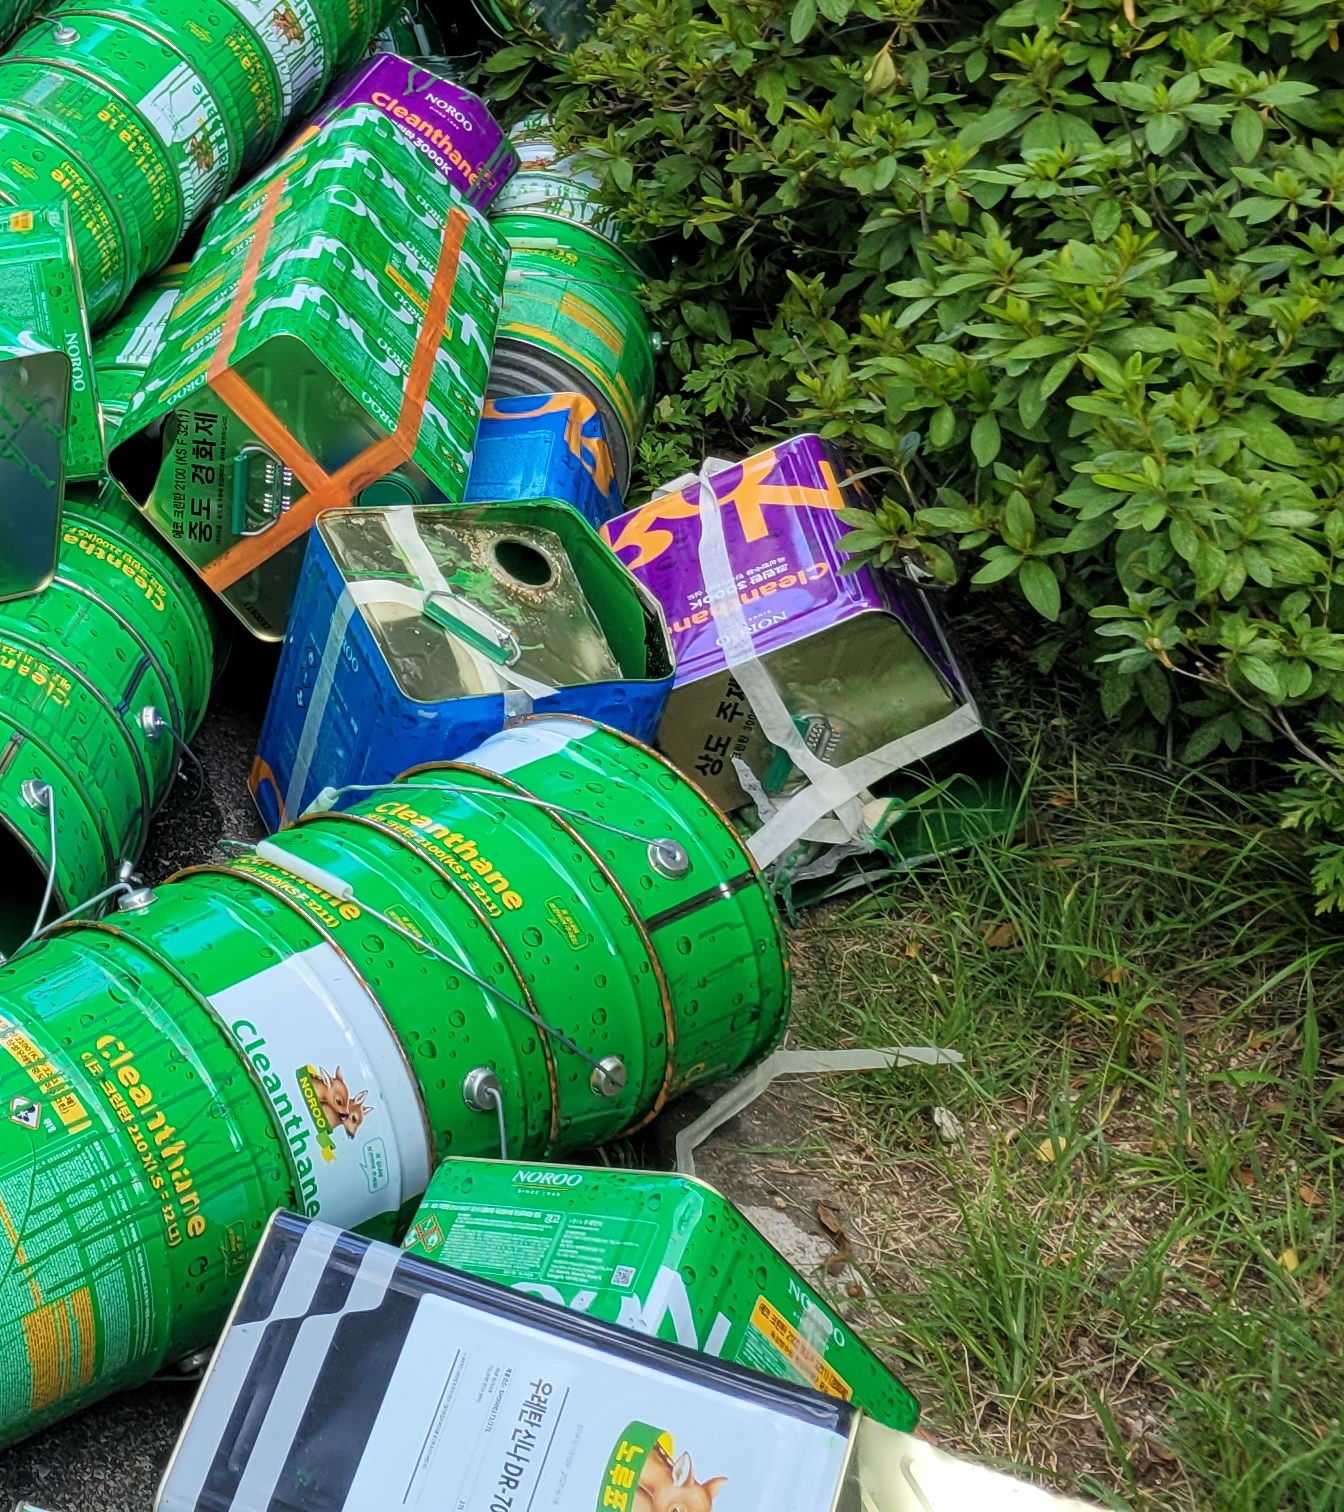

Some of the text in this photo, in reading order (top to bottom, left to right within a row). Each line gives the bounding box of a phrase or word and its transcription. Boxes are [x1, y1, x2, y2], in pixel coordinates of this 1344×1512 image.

[424, 92, 473, 132] NOROO
[373, 92, 482, 186] Cleanthane
[412, 133, 453, 176] 3000K
[64, 332, 86, 392] NOROO
[175, 408, 190, 437] 3211)
[174, 446, 188, 466] (KS
[187, 410, 219, 544] 중도 경화제
[173, 466, 187, 490] 2100
[171, 491, 186, 519] 크린탄
[171, 520, 186, 540] 에코
[714, 610, 788, 646] NORO
[694, 730, 731, 780] 상도
[375, 802, 523, 910] Cleanthane
[305, 898, 341, 929] 3211)
[469, 879, 503, 918] 3211)
[232, 1019, 320, 1218] Cleanthane
[299, 1076, 326, 1129] NOROO
[96, 1035, 206, 1238] Cleanthane
[512, 1167, 583, 1188] NOROO
[508, 1376, 555, 1466] 우레탄 신나
[603, 1439, 646, 1512] 노루표
